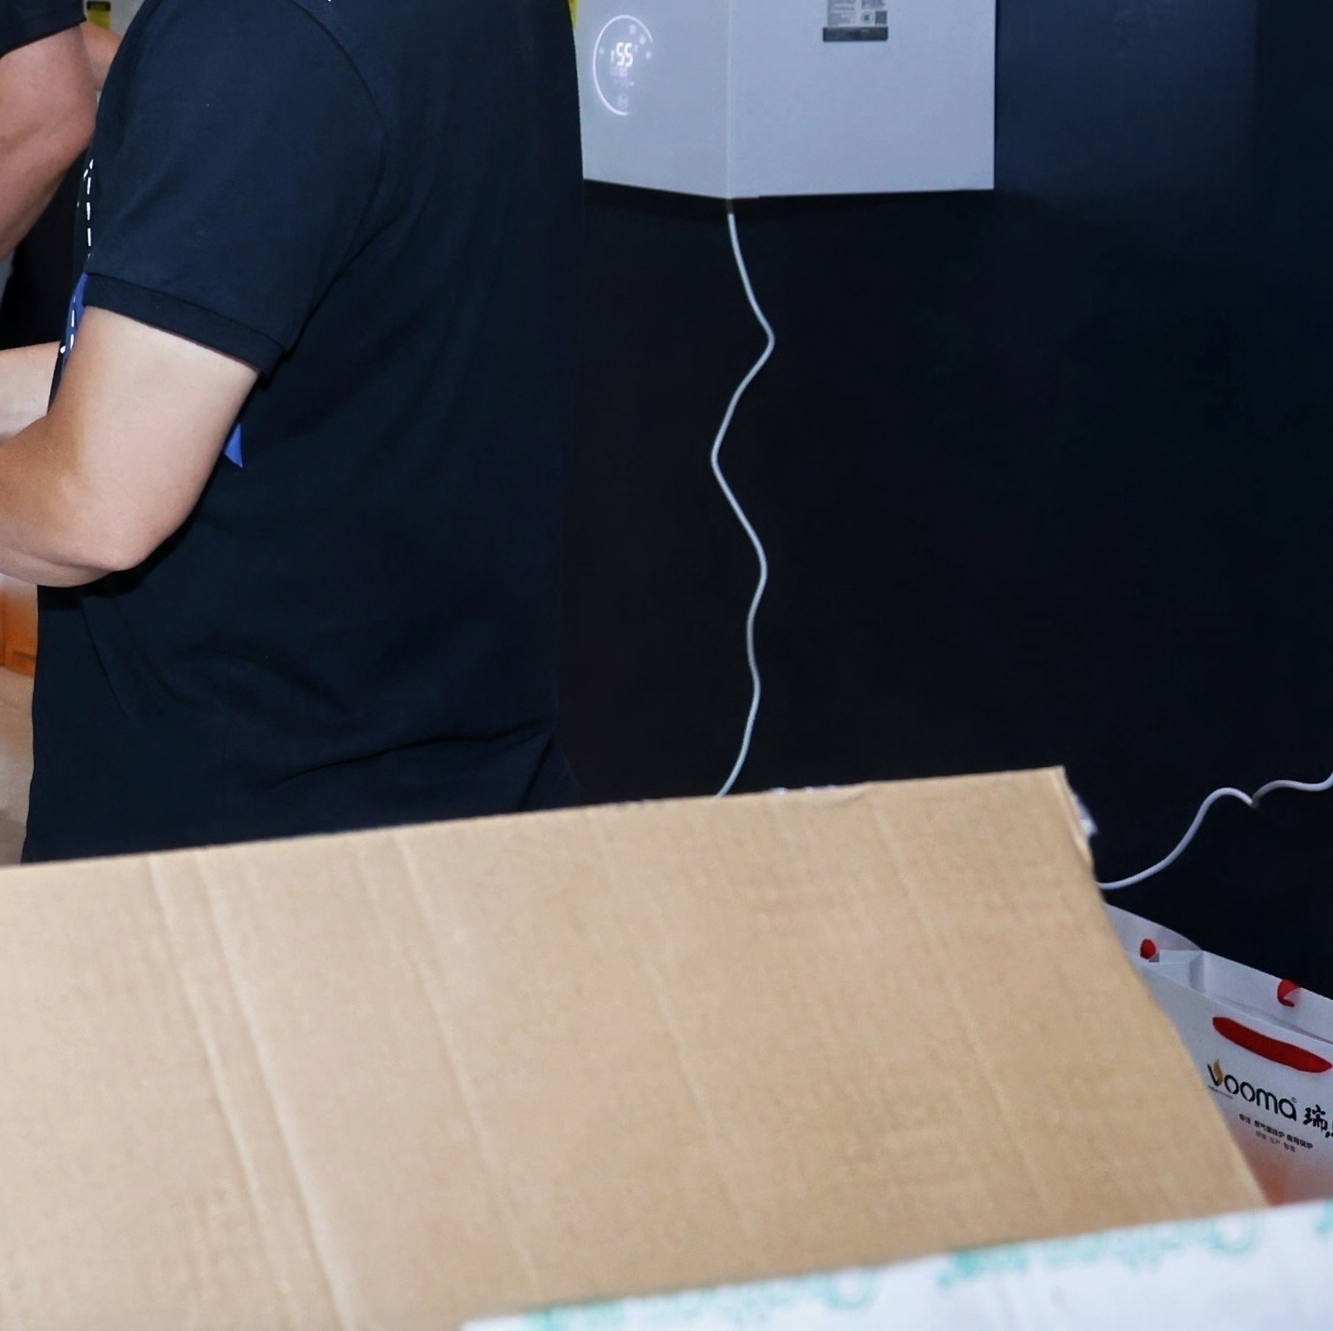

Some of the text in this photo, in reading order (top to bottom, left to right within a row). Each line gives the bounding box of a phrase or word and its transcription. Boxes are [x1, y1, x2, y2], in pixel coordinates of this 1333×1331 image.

[616, 41, 633, 67] 55
[1207, 1059, 1333, 1138] Vooma 瑞
